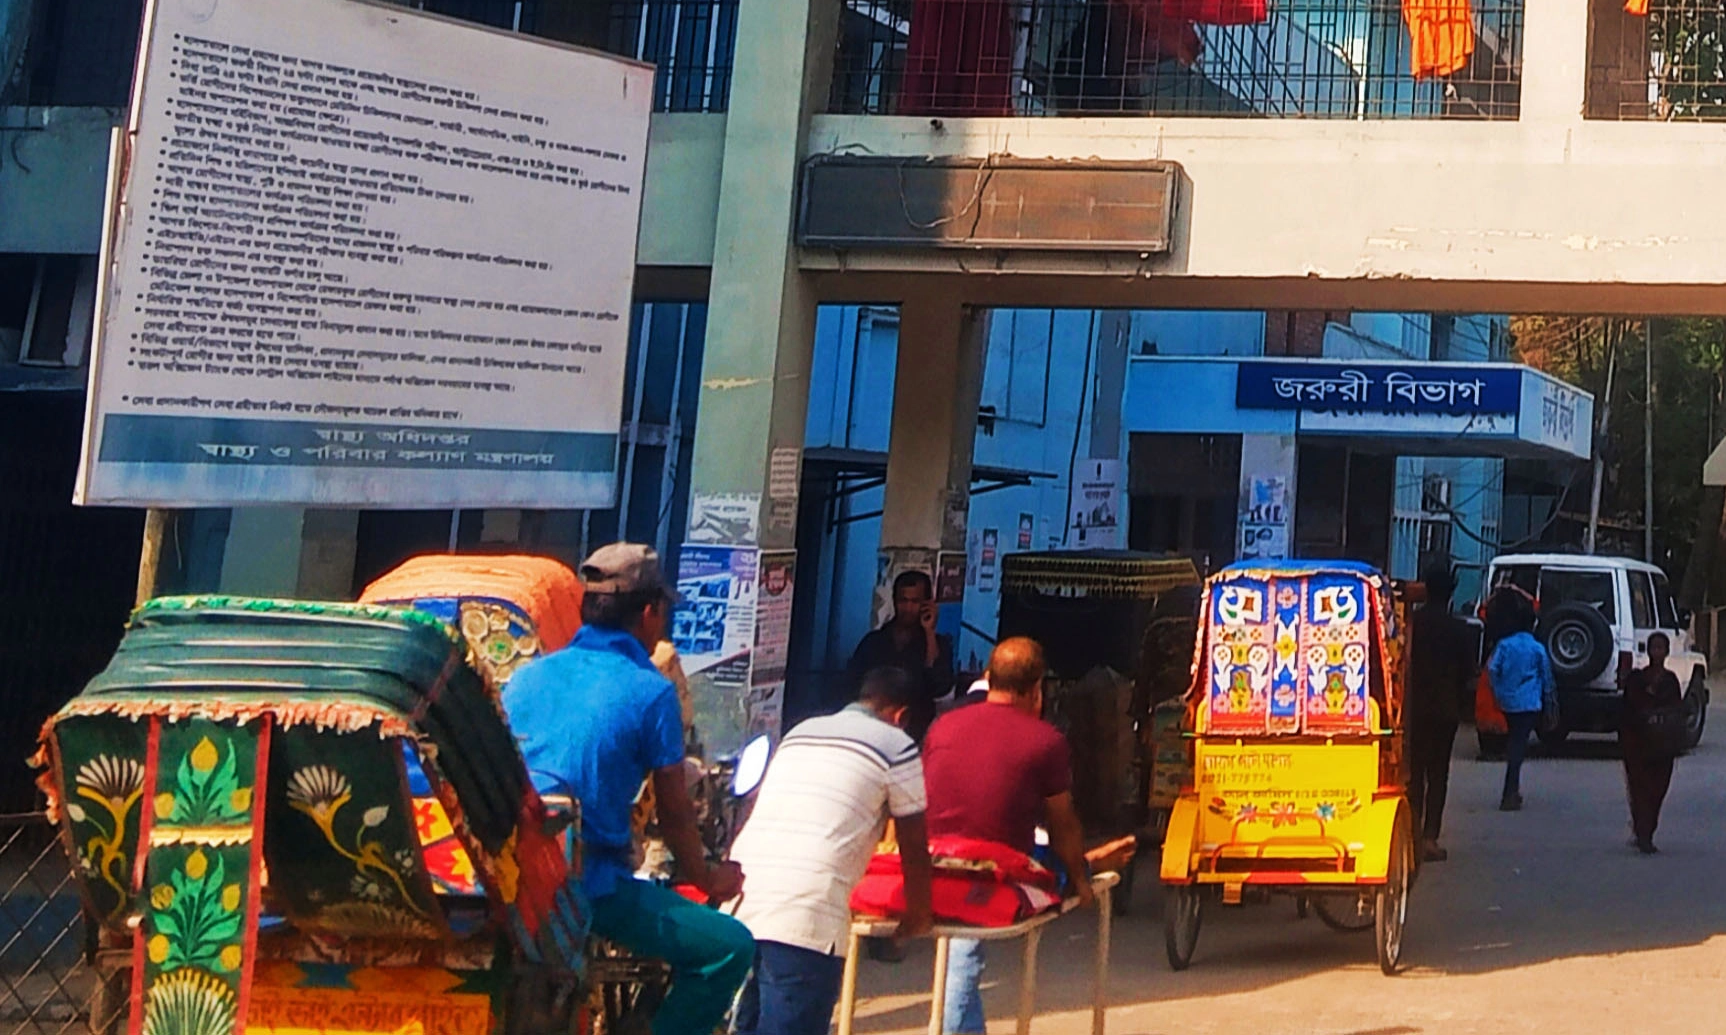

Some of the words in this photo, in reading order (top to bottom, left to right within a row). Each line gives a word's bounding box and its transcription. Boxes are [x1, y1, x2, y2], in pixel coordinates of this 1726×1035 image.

[1272, 369, 1374, 403] জরুরী
[1384, 371, 1486, 406] বিভাগ
[269, 447, 292, 459] ও
[302, 444, 387, 462] পরিবার
